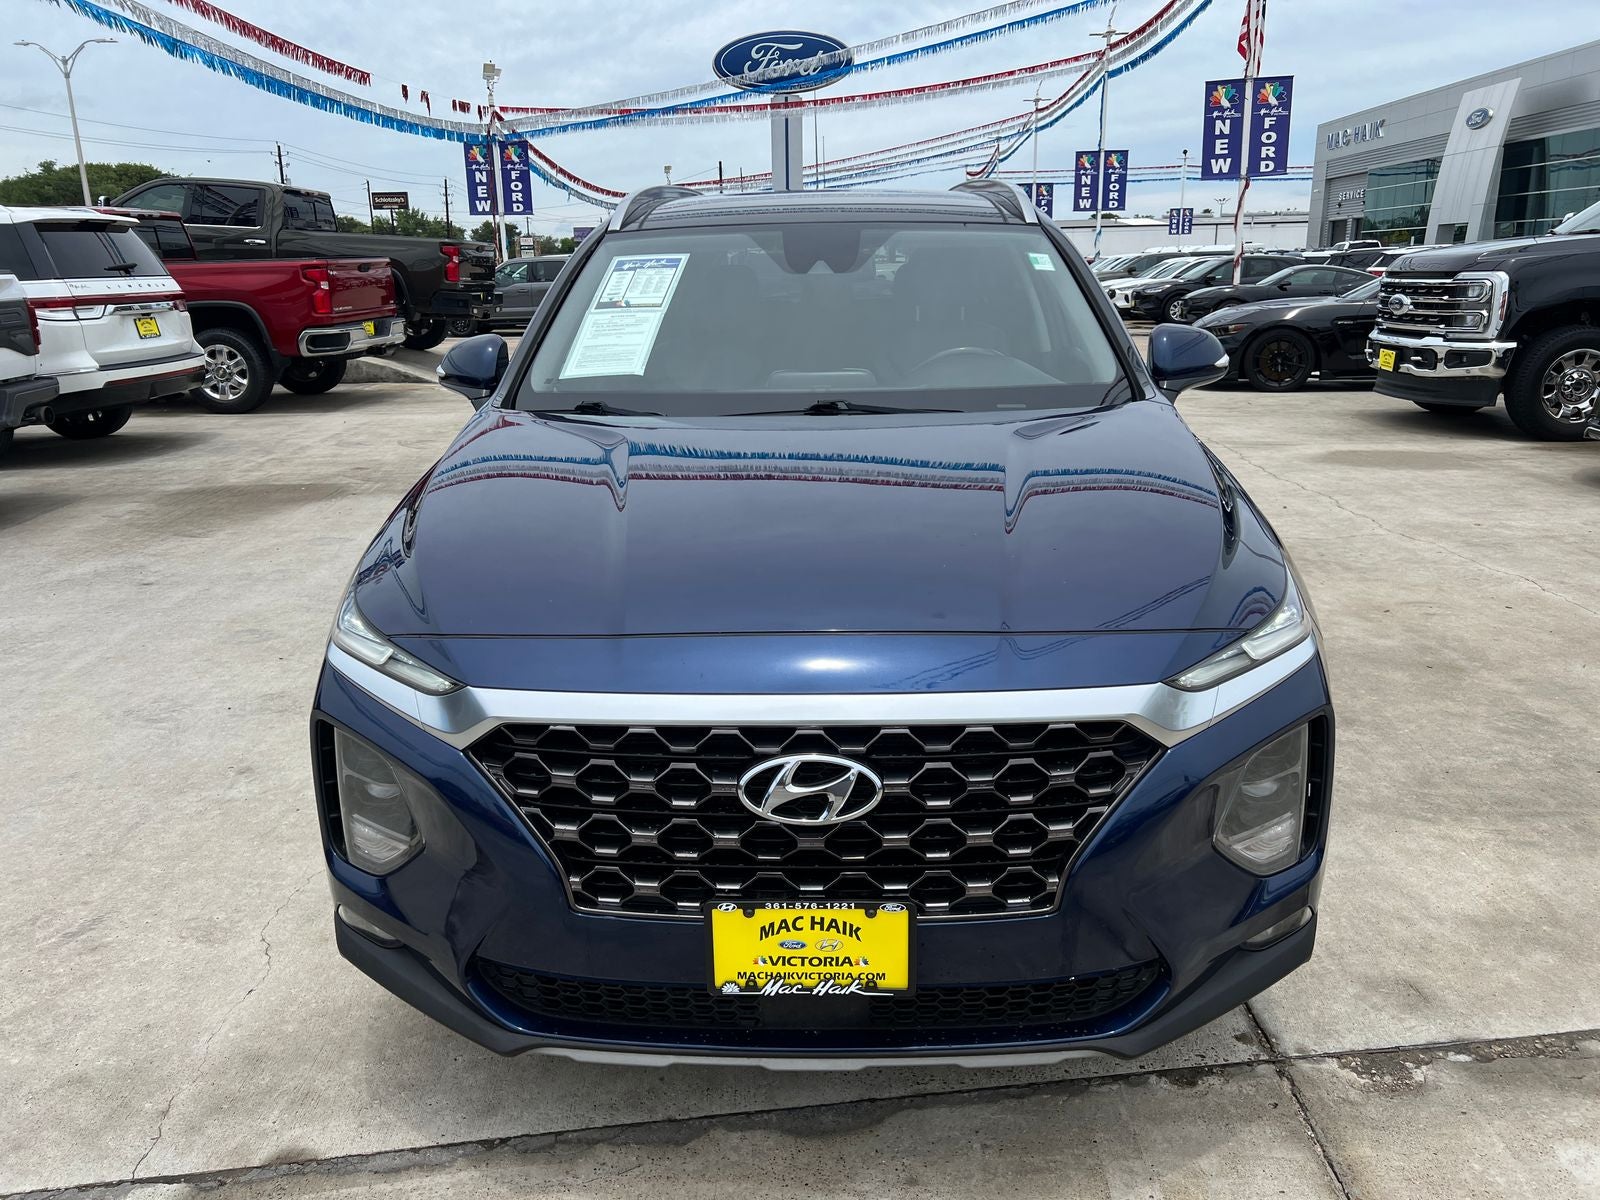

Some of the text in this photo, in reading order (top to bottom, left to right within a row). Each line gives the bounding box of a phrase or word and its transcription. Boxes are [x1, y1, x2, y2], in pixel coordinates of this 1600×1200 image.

[744, 42, 824, 76] Ford
[1210, 119, 1232, 174] NEW
[1260, 117, 1277, 172] FORD
[1326, 119, 1386, 150] MAC HAIK
[475, 171, 491, 212] NEW
[510, 171, 524, 212] FORD
[1079, 175, 1092, 209] NEW
[1108, 174, 1120, 209] FORD
[1338, 189, 1366, 201] SERVICE
[765, 902, 856, 910] 361-576-1221
[759, 915, 863, 943] MAC HAIK
[782, 940, 802, 949] Ford
[768, 955, 854, 967] VICTORIA
[760, 978, 867, 997] Mac Haik
